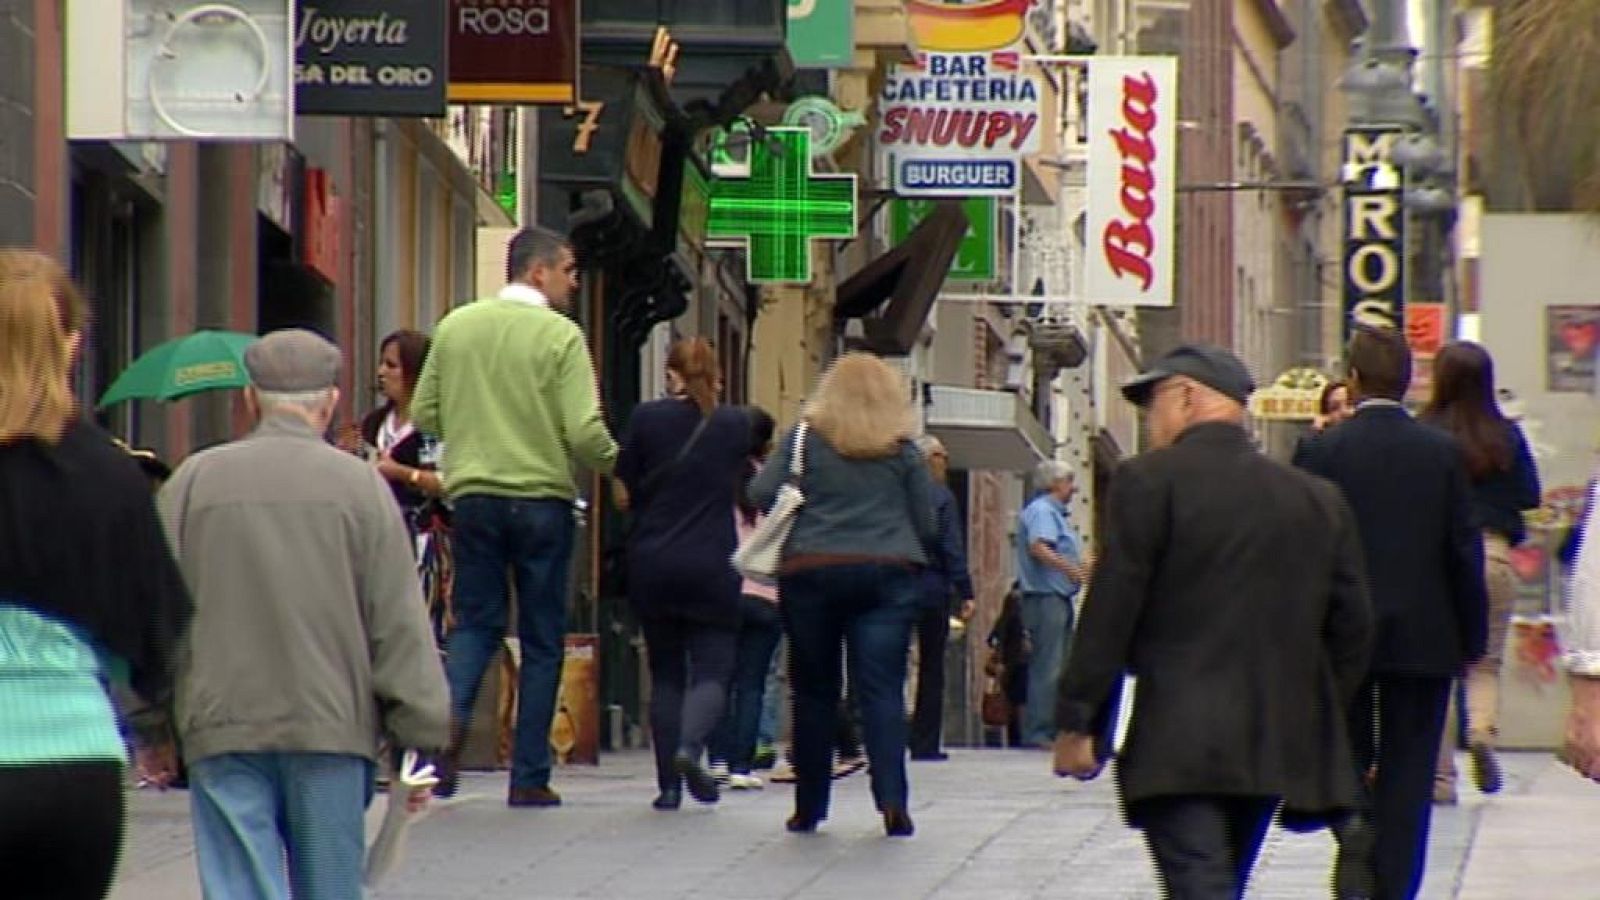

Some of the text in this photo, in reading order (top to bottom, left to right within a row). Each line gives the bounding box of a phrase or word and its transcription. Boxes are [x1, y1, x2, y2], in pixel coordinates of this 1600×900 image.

[295, 7, 408, 53] Joyería
[330, 64, 372, 84] DEL
[377, 65, 433, 86] ORO
[930, 55, 985, 76] BAR
[882, 75, 1037, 101] CAFETERÍA
[880, 105, 1038, 149] SNUUPY
[906, 164, 1010, 184] BURGUER
[1104, 71, 1157, 292] Bata
